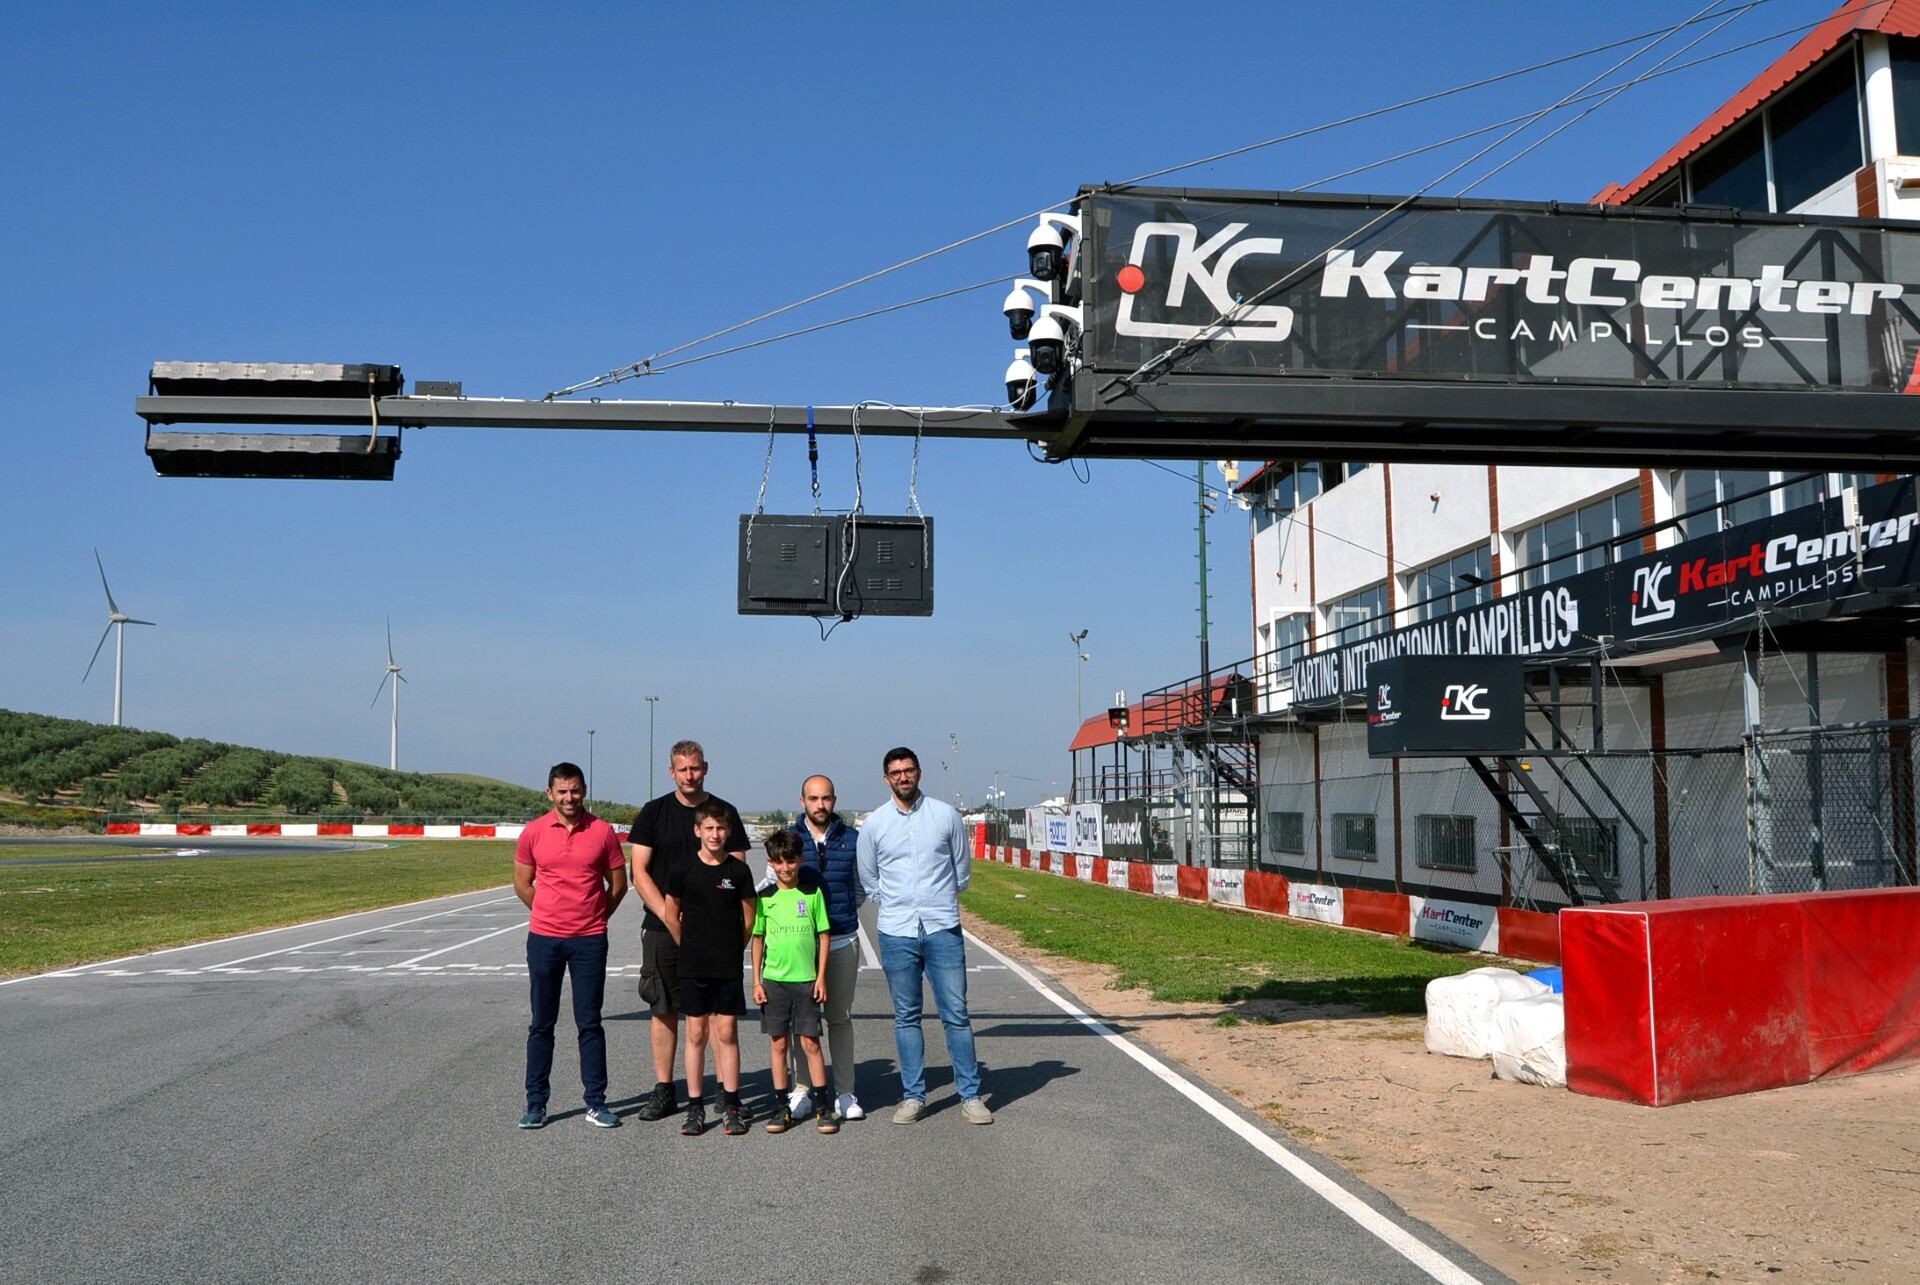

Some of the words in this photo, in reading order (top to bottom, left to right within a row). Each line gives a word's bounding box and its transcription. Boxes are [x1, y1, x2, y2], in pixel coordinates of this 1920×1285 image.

[1320, 249, 1903, 316] KartCenter
[1475, 318, 1764, 348] CAMPILLOS
[1679, 511, 1920, 594] KartCenter
[1731, 566, 1854, 606] CAMPILLOS
[1293, 652, 1339, 702] KARTING
[1456, 586, 1572, 655] CAMPILLOS
[1103, 812, 1143, 846] finetwork
[1421, 905, 1484, 929] KartCenter
